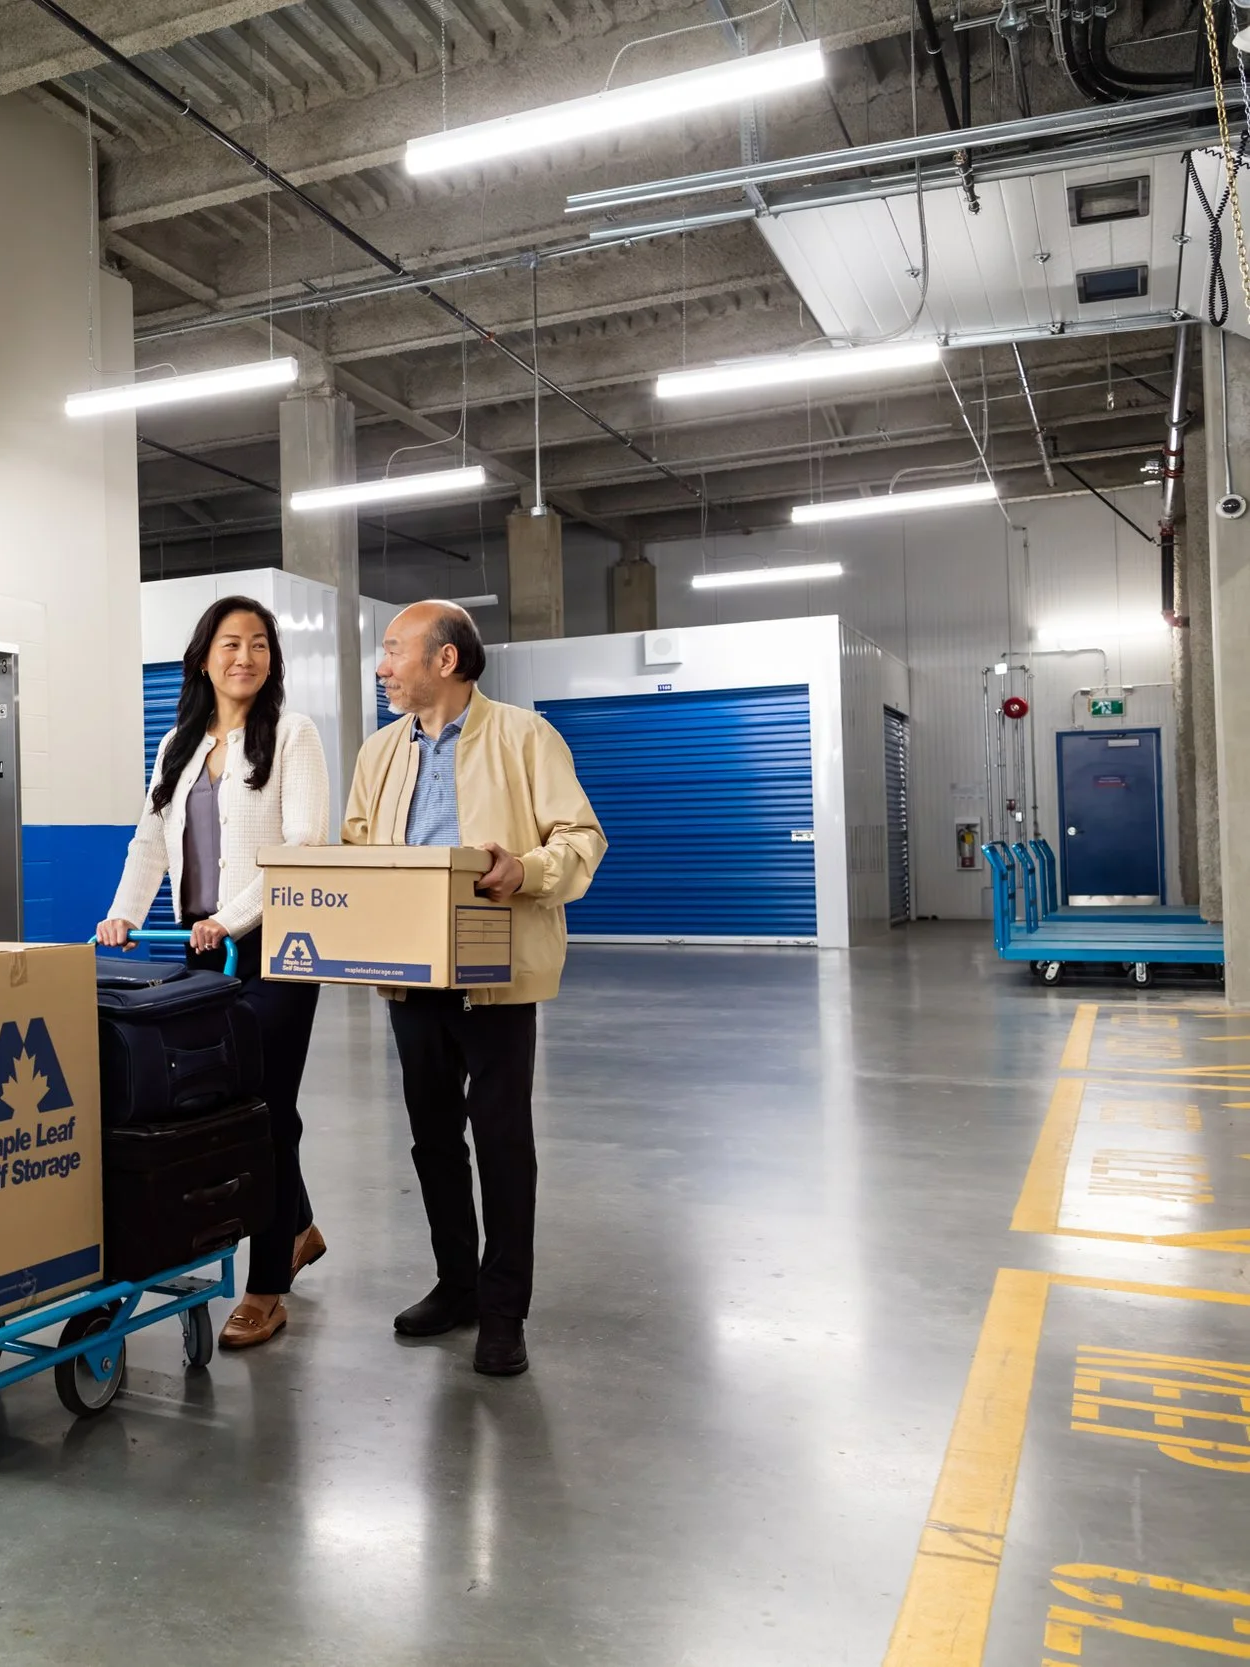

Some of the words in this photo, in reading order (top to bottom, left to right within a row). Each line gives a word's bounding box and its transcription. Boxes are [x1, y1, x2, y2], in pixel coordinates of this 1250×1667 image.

[2, 660, 8, 674] 3
[271, 886, 304, 907] File
[311, 888, 348, 907] Box
[283, 959, 299, 967] Maple
[293, 965, 313, 973] Storage
[344, 967, 404, 976] mapleleafstorage.com
[36, 1116, 75, 1148] Leaf
[11, 1151, 81, 1185] Storage
[1070, 1345, 1250, 1474] KEEP
